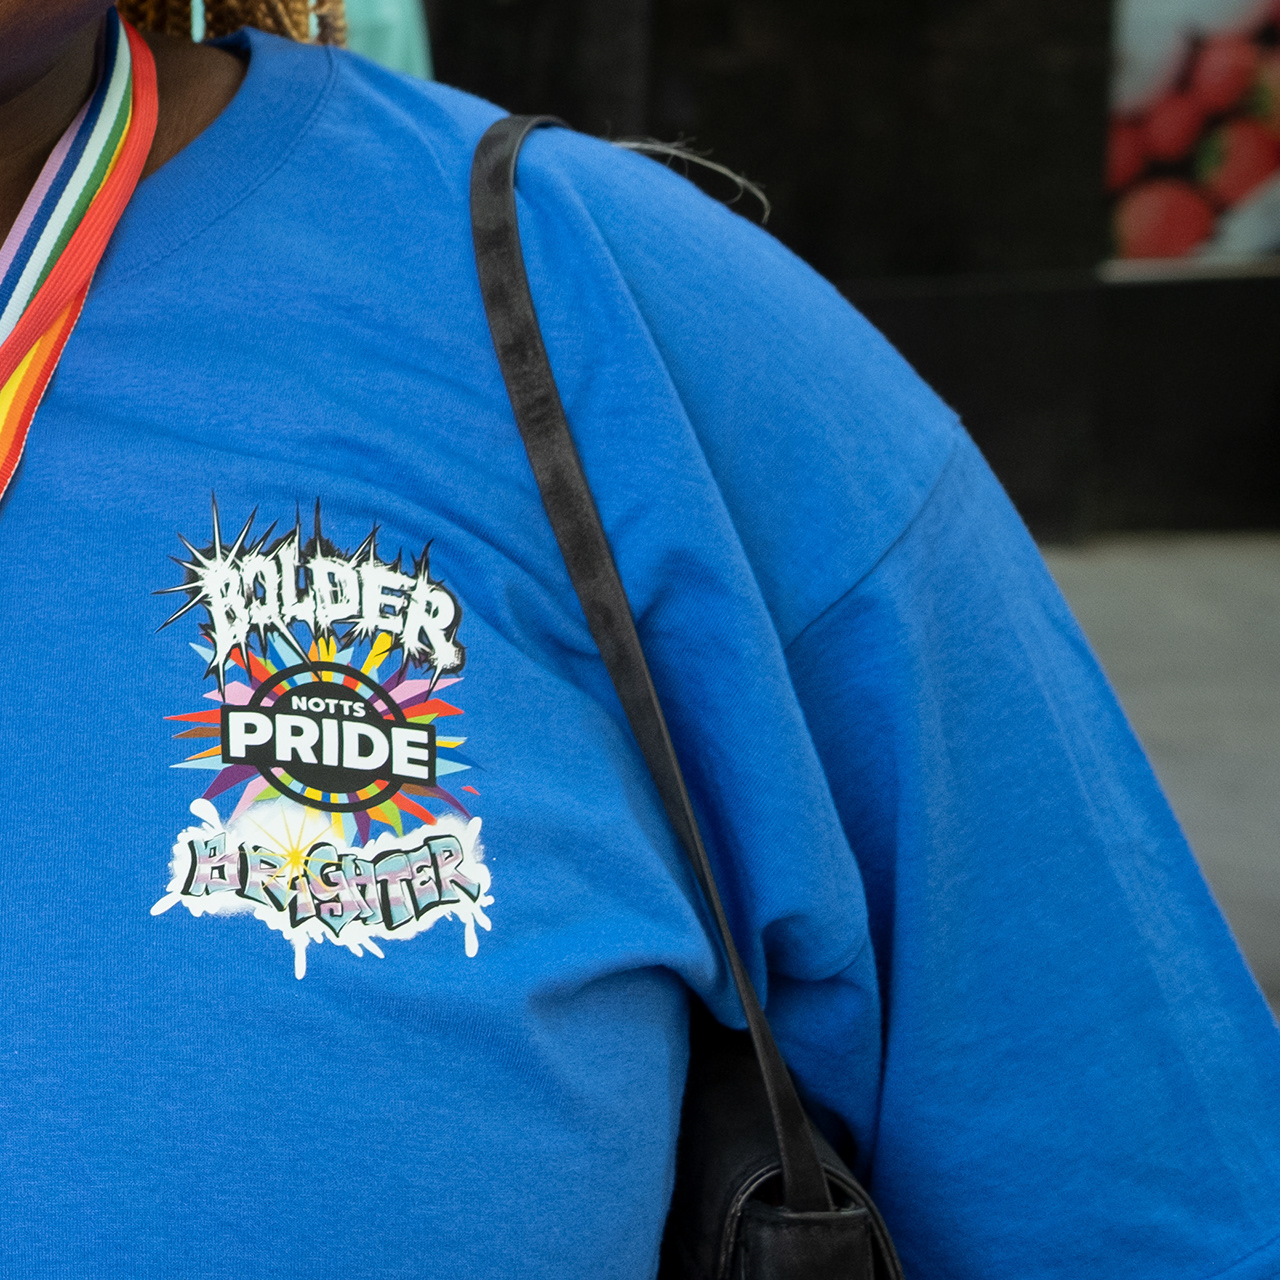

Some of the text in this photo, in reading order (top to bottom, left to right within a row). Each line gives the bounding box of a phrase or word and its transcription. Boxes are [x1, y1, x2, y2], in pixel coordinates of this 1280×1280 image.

[175, 520, 466, 685] BOLDER
[227, 711, 431, 781] PRIDE
[291, 695, 366, 719] NOTTS
[180, 832, 482, 937] BRIGHTER
